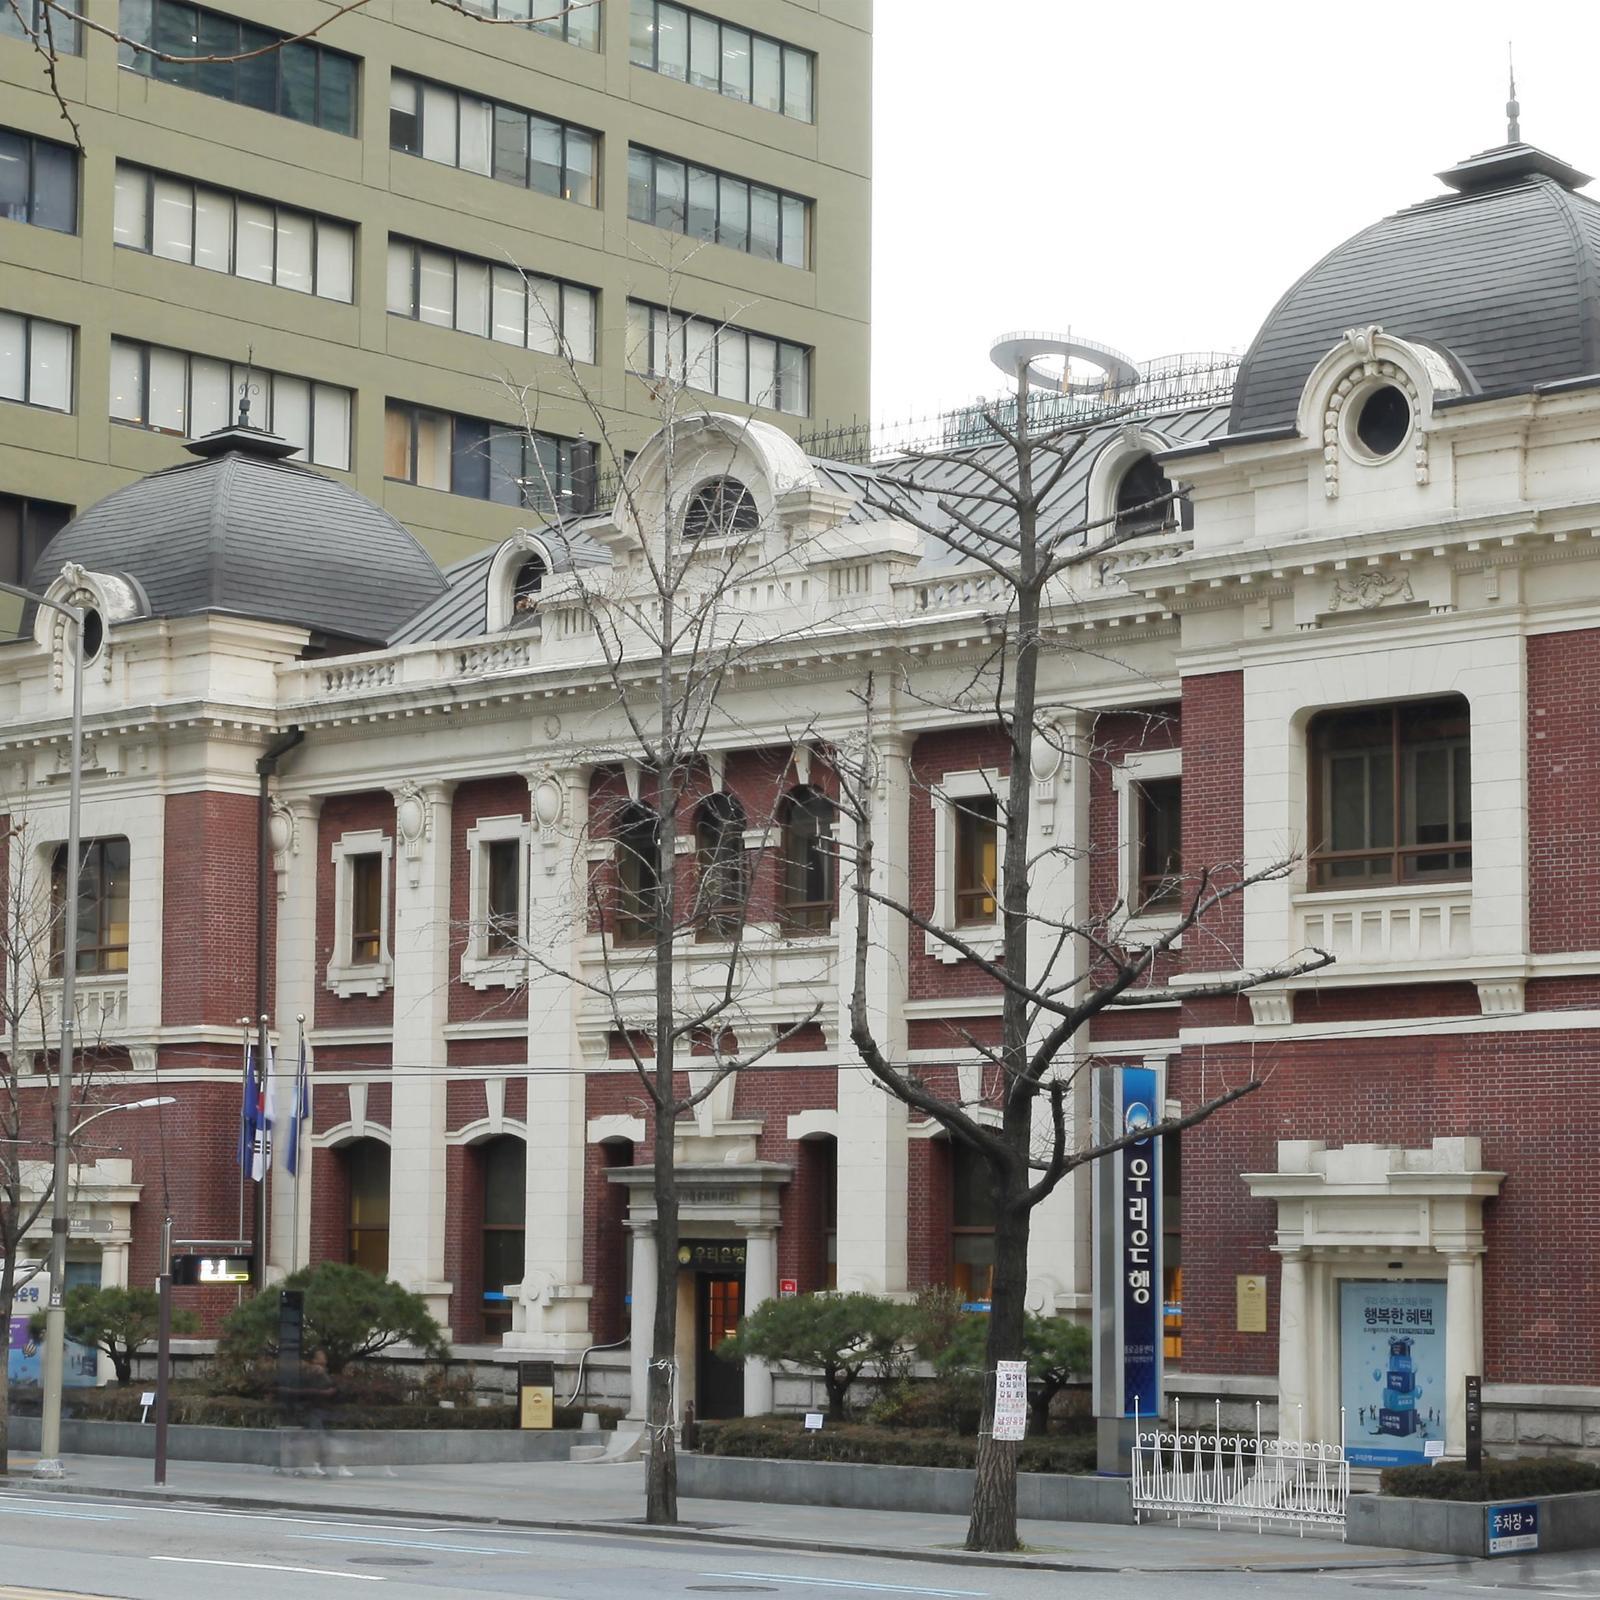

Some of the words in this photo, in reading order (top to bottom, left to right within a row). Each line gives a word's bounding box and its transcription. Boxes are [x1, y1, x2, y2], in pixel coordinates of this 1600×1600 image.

[1128, 1158, 1151, 1304] 우리은행
[695, 1246, 745, 1264] 우리은행
[1364, 1307, 1404, 1325] 행복한
[1406, 1308, 1433, 1326] 혜택
[1493, 1512, 1522, 1533] 주차장
